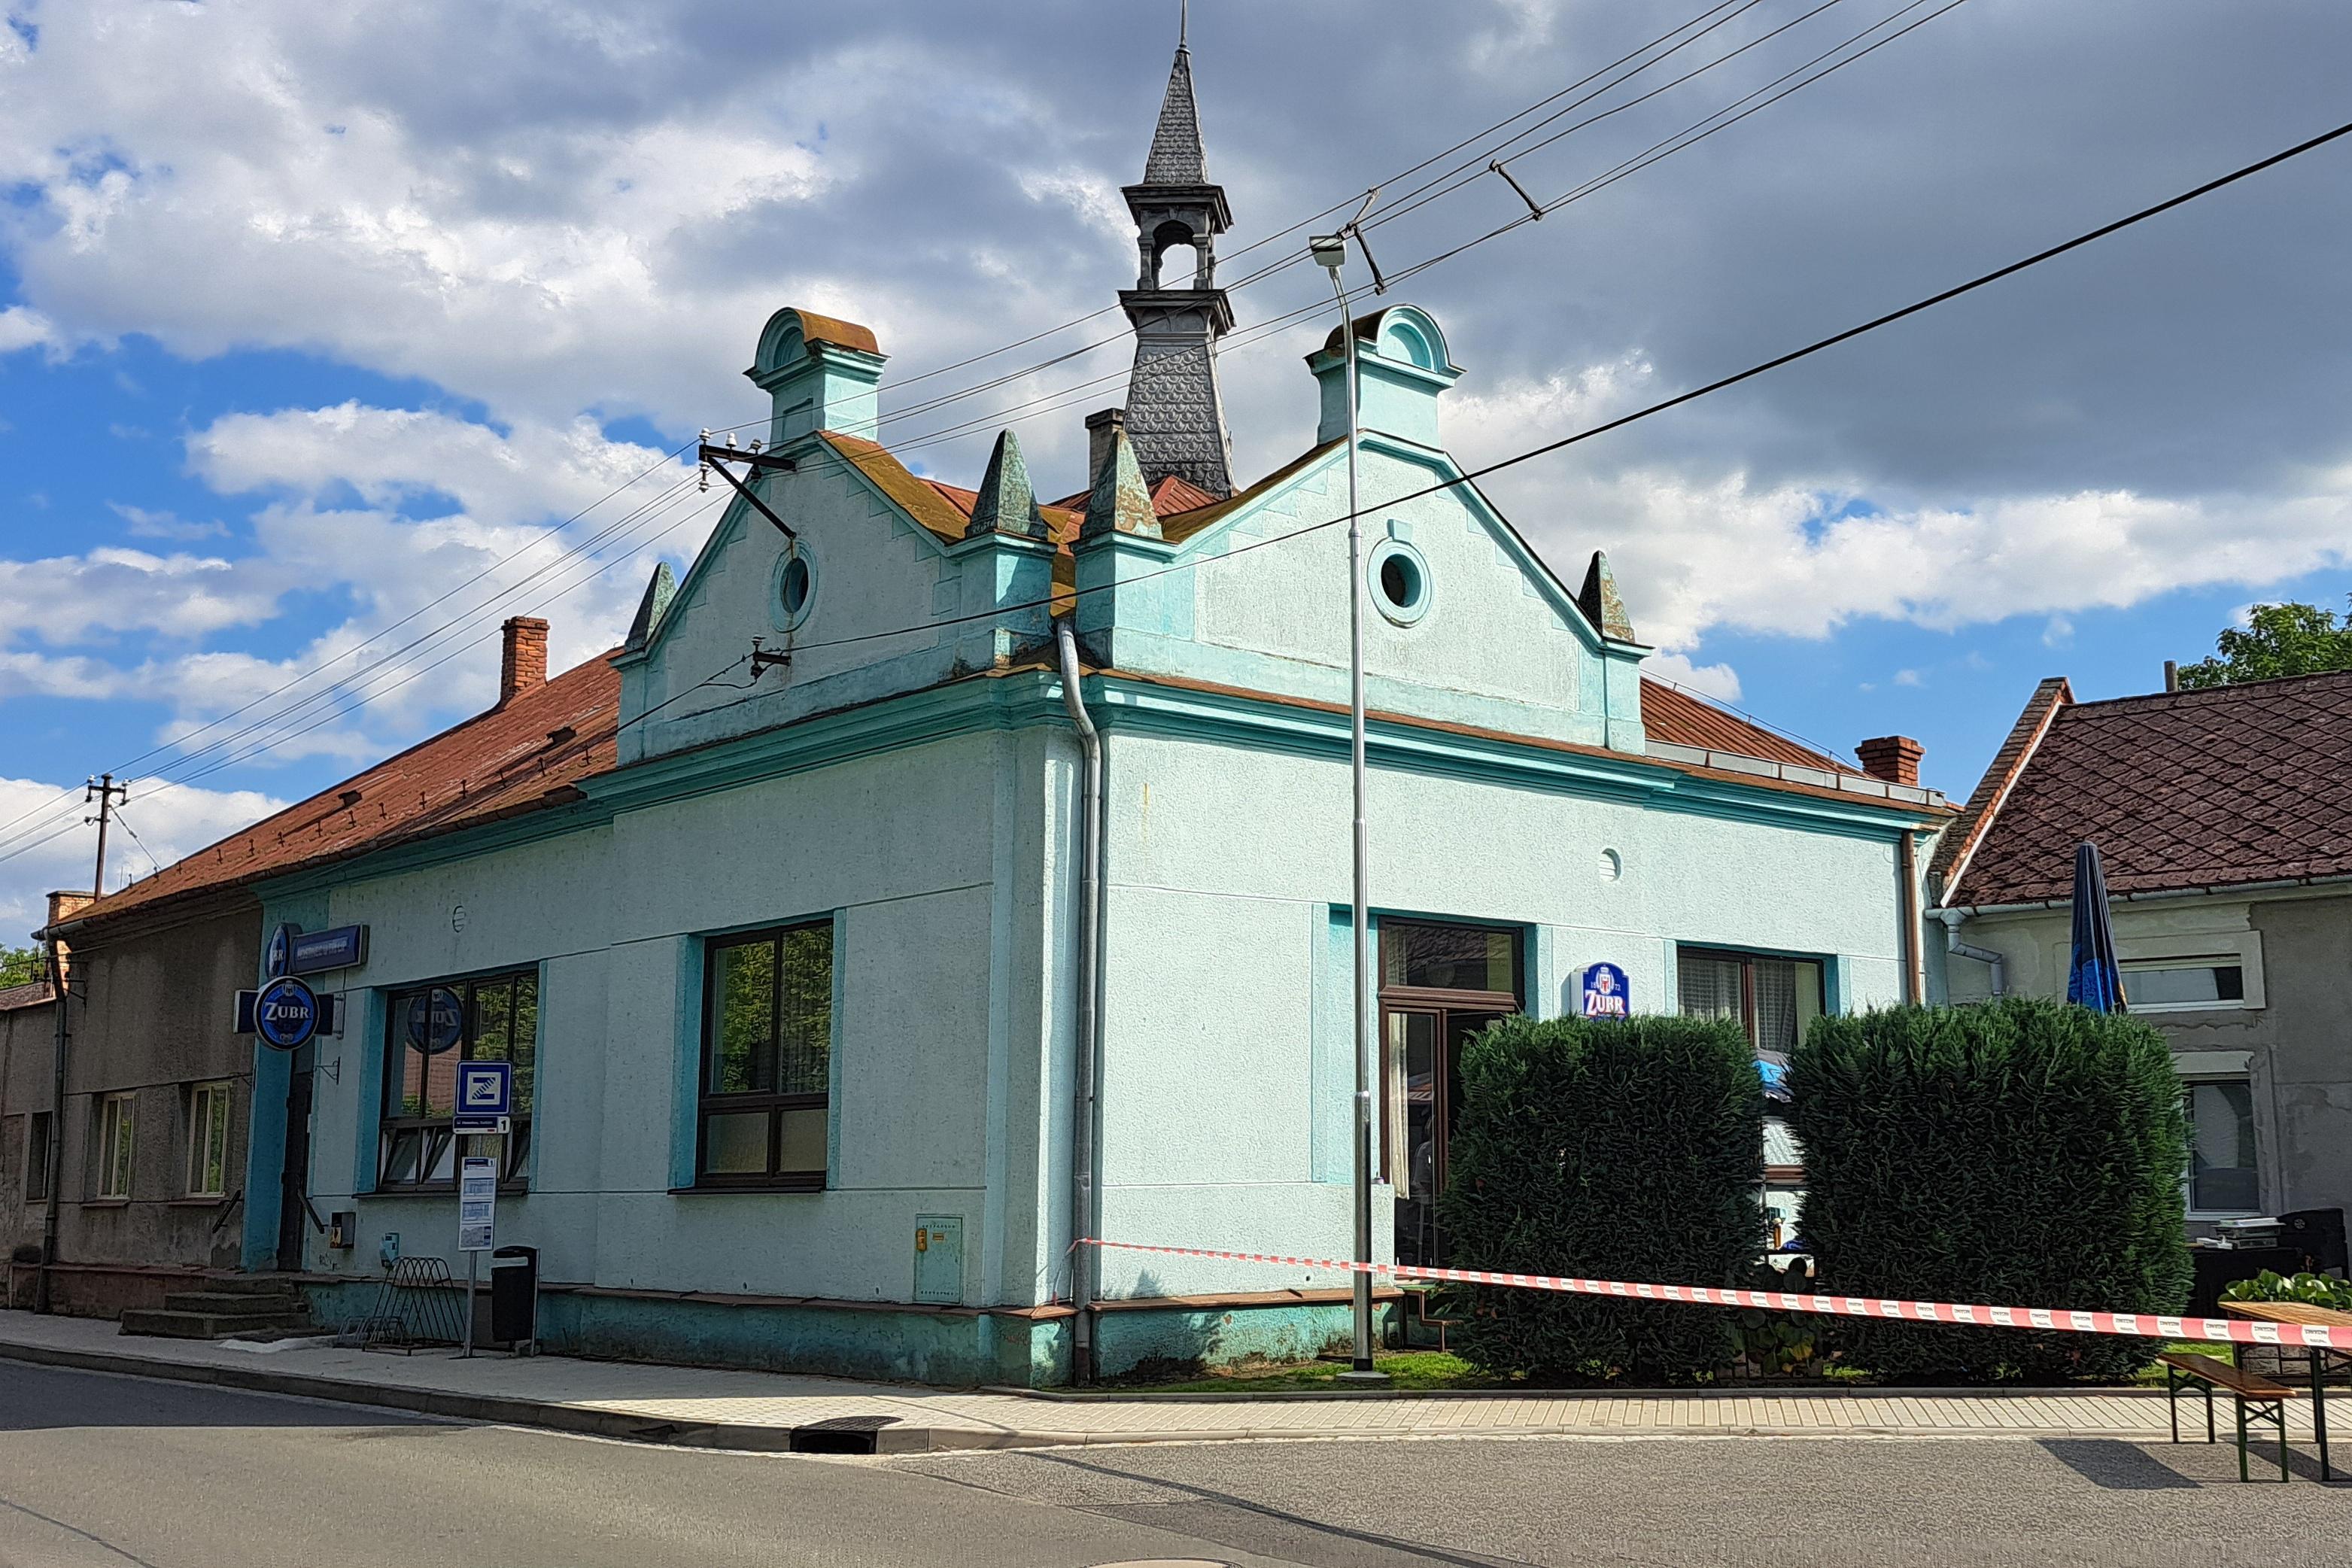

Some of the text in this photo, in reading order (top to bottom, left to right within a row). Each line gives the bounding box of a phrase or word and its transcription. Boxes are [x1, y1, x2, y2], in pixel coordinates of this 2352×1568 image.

[264, 1001, 309, 1021] ZUBR
[1585, 989, 1626, 1016] ZUBR
[500, 1120, 506, 1131] 1
